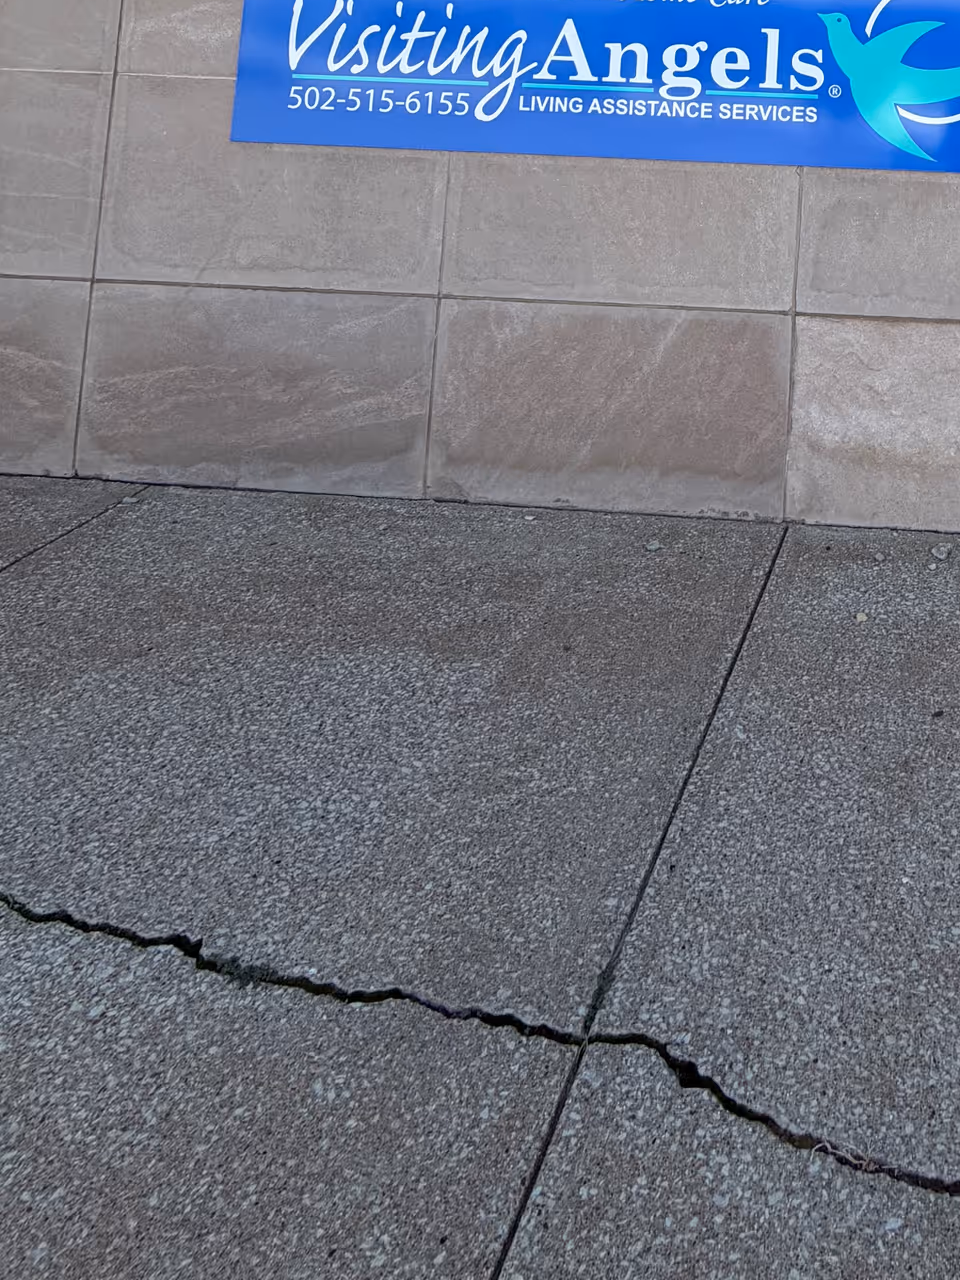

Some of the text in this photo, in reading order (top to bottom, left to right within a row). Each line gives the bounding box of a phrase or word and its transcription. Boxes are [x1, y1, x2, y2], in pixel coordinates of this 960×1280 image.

[287, 85, 470, 117] 502-515-6155
[518, 95, 818, 124] LIVING ASSISTANCE SERVICES
